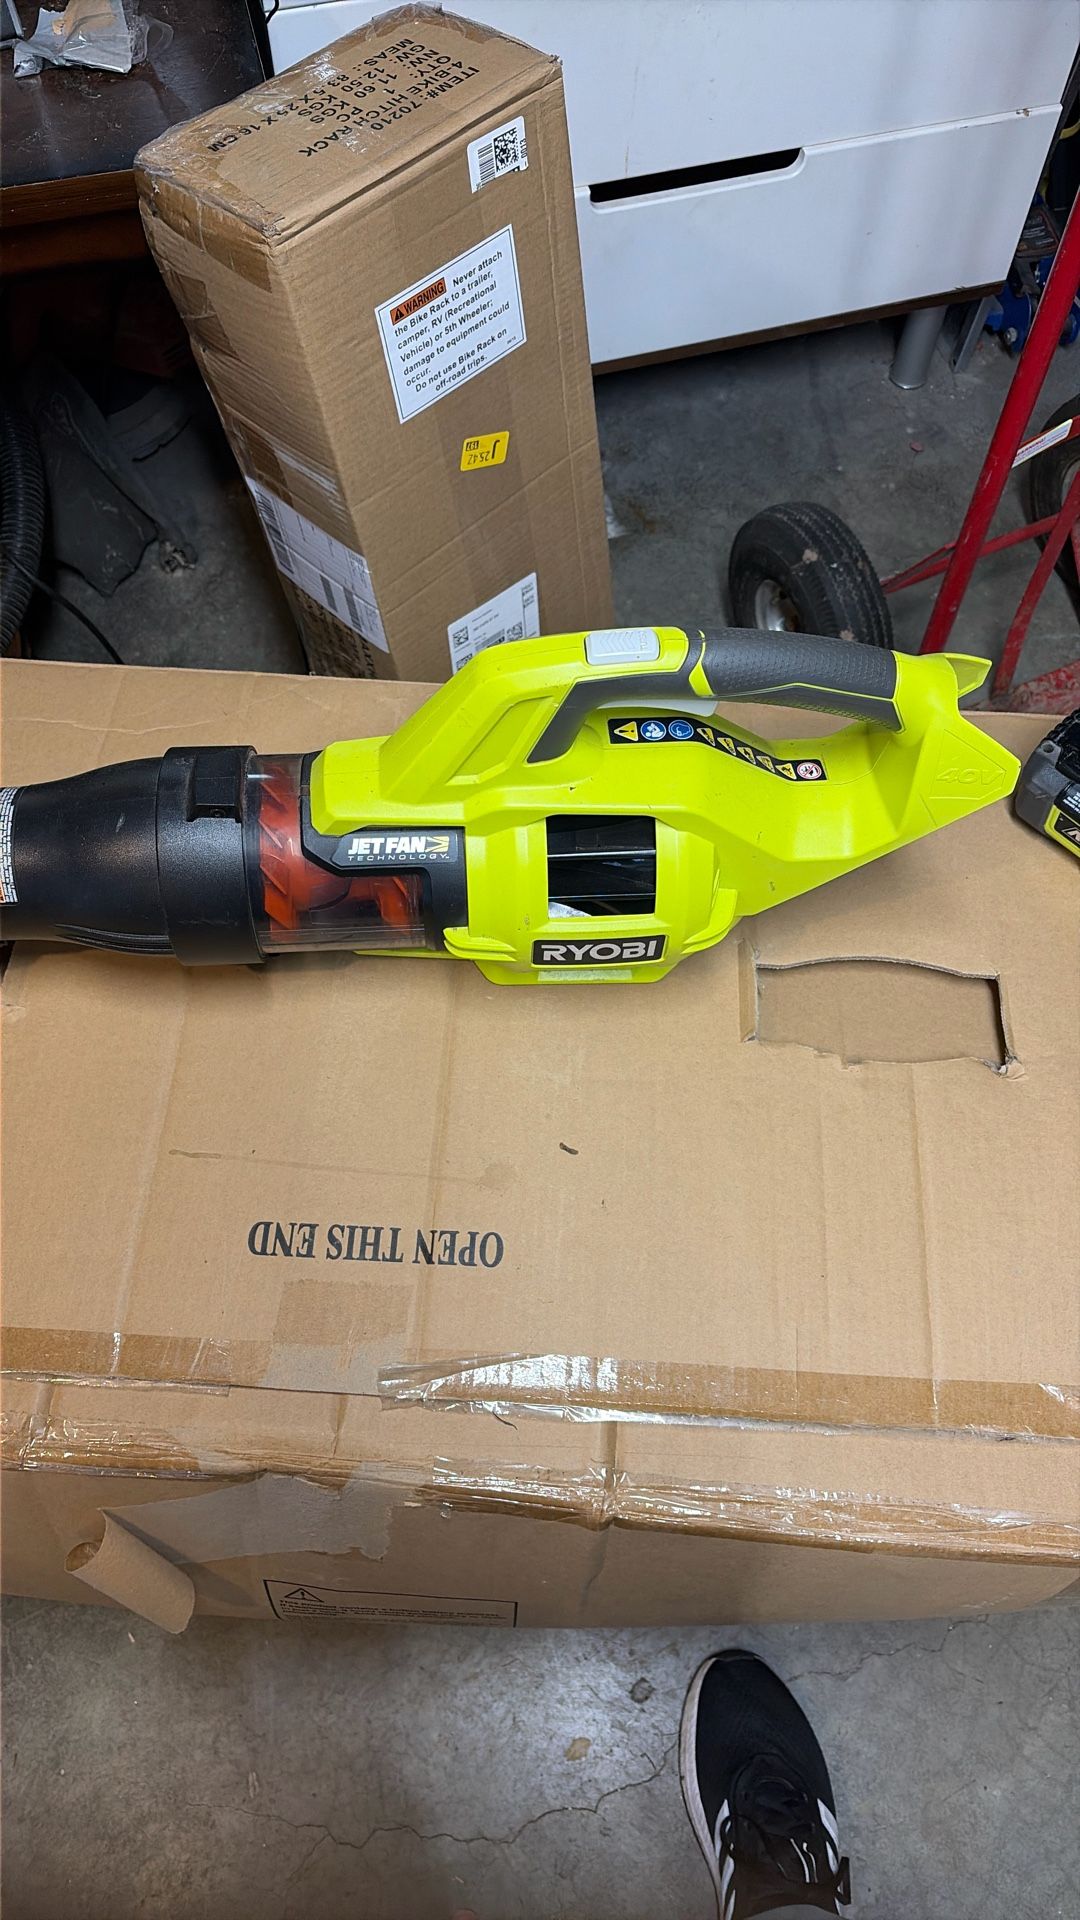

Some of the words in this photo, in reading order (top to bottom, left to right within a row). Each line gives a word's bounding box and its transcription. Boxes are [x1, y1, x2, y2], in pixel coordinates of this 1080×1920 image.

[394, 44, 425, 65] GW:
[404, 49, 440, 68] NW:
[410, 55, 452, 78] QTY:
[313, 74, 350, 95] 83.5
[344, 66, 385, 93] 12.50
[354, 73, 398, 99] 11.60
[407, 61, 463, 95] 4-BIKE
[299, 95, 338, 117] KGS
[309, 100, 351, 124] KGS
[336, 106, 363, 123] PC
[353, 93, 409, 127] HITCH
[371, 100, 422, 131] 70210
[207, 133, 239, 152] CM
[299, 126, 353, 157] RACK
[403, 282, 445, 315] WARNING
[452, 268, 476, 287] Never
[478, 251, 503, 273] attach
[394, 325, 408, 337] the
[410, 312, 429, 327] Bike
[429, 299, 449, 316] Rack
[451, 292, 460, 302] to
[468, 271, 494, 291] trailer,
[397, 326, 431, 351] camper,
[431, 316, 443, 328] RV
[444, 281, 497, 322] (Recreational
[400, 338, 434, 363] Vehicle)
[434, 331, 443, 342] or
[444, 319, 458, 336] 5th
[403, 351, 440, 376] damage
[436, 344, 445, 355] to
[446, 318, 487, 350] equipment
[488, 301, 510, 322] could
[415, 381, 427, 393] Do
[428, 371, 441, 385] not
[442, 362, 457, 375] use
[458, 349, 476, 366] Bike
[477, 335, 496, 355] Rack
[497, 327, 507, 337] on
[435, 366, 466, 391] off-road
[467, 353, 488, 372] trips.
[406, 367, 431, 387] occur.
[491, 439, 501, 459] J
[348, 837, 385, 855] JET
[385, 836, 426, 853] FAN
[541, 940, 657, 961] RYOBI
[248, 1221, 319, 1258] END
[325, 1224, 404, 1263] THIS
[412, 1229, 504, 1268] OPEN
